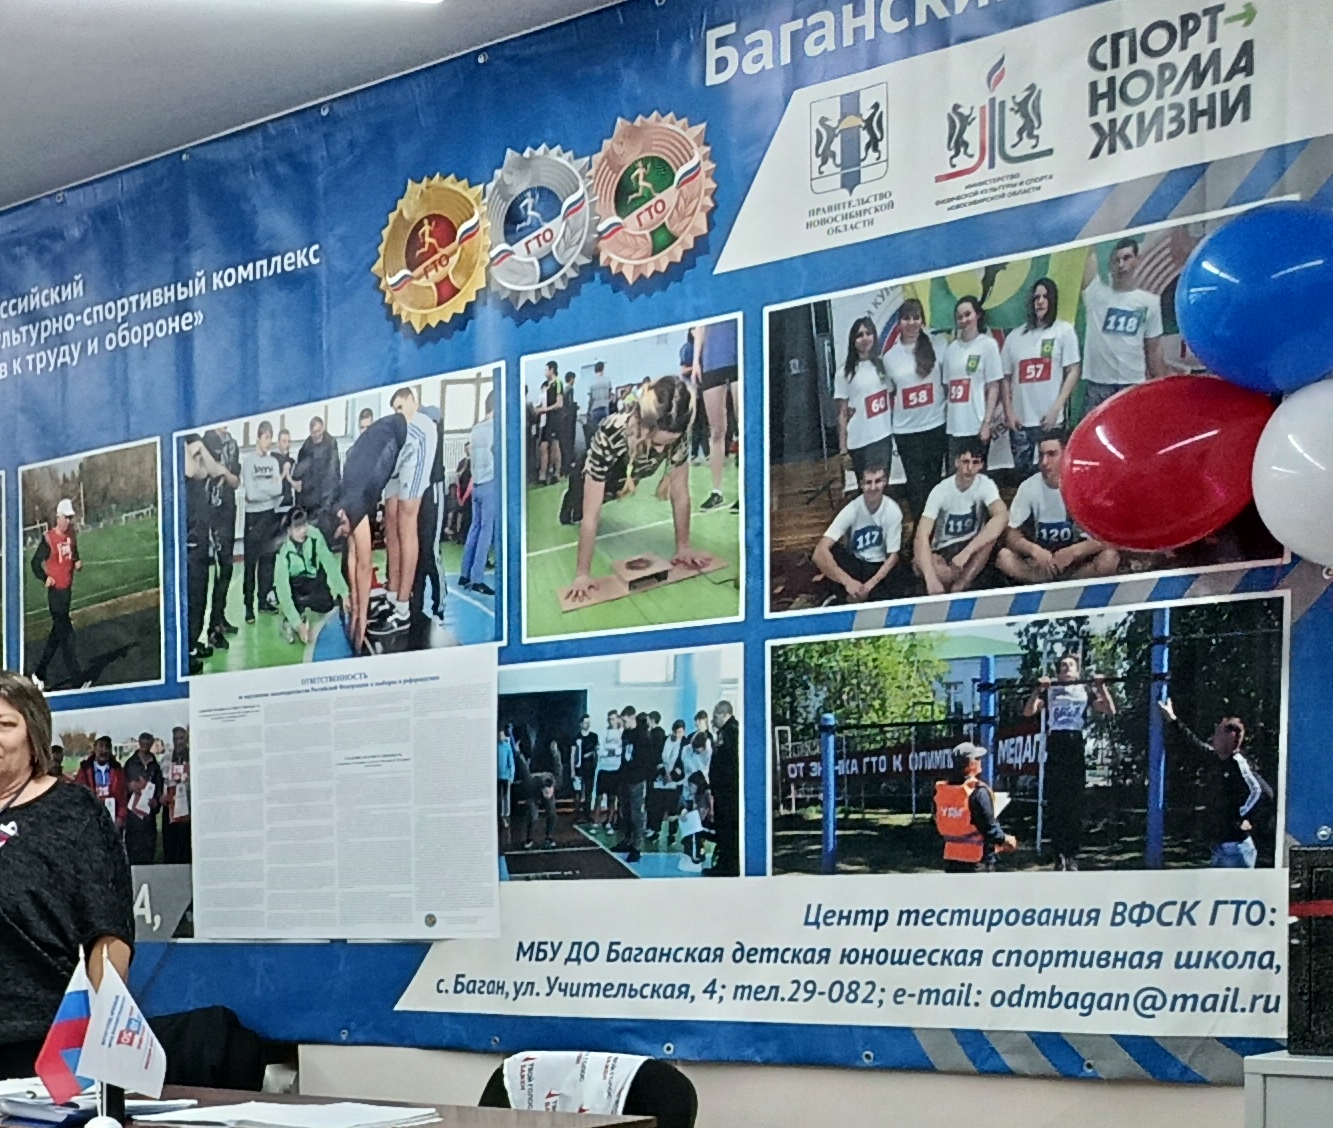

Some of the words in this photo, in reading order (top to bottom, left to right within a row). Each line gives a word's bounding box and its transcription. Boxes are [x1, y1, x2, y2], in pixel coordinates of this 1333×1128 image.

[705, 0, 1002, 86] Баганск
[1087, 3, 1225, 72] СПОРТ
[1088, 38, 1254, 118] НОРМА
[1088, 83, 1251, 160] ЖИЗНИ
[636, 199, 666, 227] ГТО
[806, 200, 895, 229] НОВОСИБИРСКОЙ
[808, 191, 893, 217] ПРАВИТЕЛЬСТВО
[827, 218, 874, 236] ОБЛАСТИ
[524, 228, 554, 255] ГТО
[212, 243, 321, 291] комплекс
[423, 254, 450, 280] ГТО
[1106, 315, 1138, 333] 118
[13, 356, 22, 375] к
[26, 341, 81, 374] труду
[87, 337, 98, 356] и
[105, 310, 204, 350] обороне»
[1025, 363, 1044, 379] 57
[871, 396, 886, 412] 60
[908, 389, 928, 406] 58
[856, 531, 880, 549] 117
[1040, 528, 1072, 542] 120
[301, 672, 368, 685] ОТВЕТСТВЕННОСТЬ
[787, 762, 805, 778] ОТ
[863, 755, 887, 774] ГТО
[892, 754, 902, 772] К
[803, 903, 890, 932] Центр
[896, 906, 1100, 933] тестирования
[1110, 900, 1202, 928] ВФСК
[1208, 900, 1278, 928] ГТО:
[516, 940, 562, 963] МБУ
[564, 940, 600, 966] ДО
[606, 941, 724, 964] Баганская
[732, 941, 831, 965] детская
[839, 946, 983, 967] юношеская
[991, 946, 1164, 974] спортивная
[1173, 949, 1283, 975] школа,
[436, 978, 449, 995] с.
[545, 976, 697, 1003] Учительская,
[702, 978, 727, 1004] 4;
[892, 981, 982, 1010] e-mail:
[989, 983, 1281, 1019] odmbagan@mail.ru
